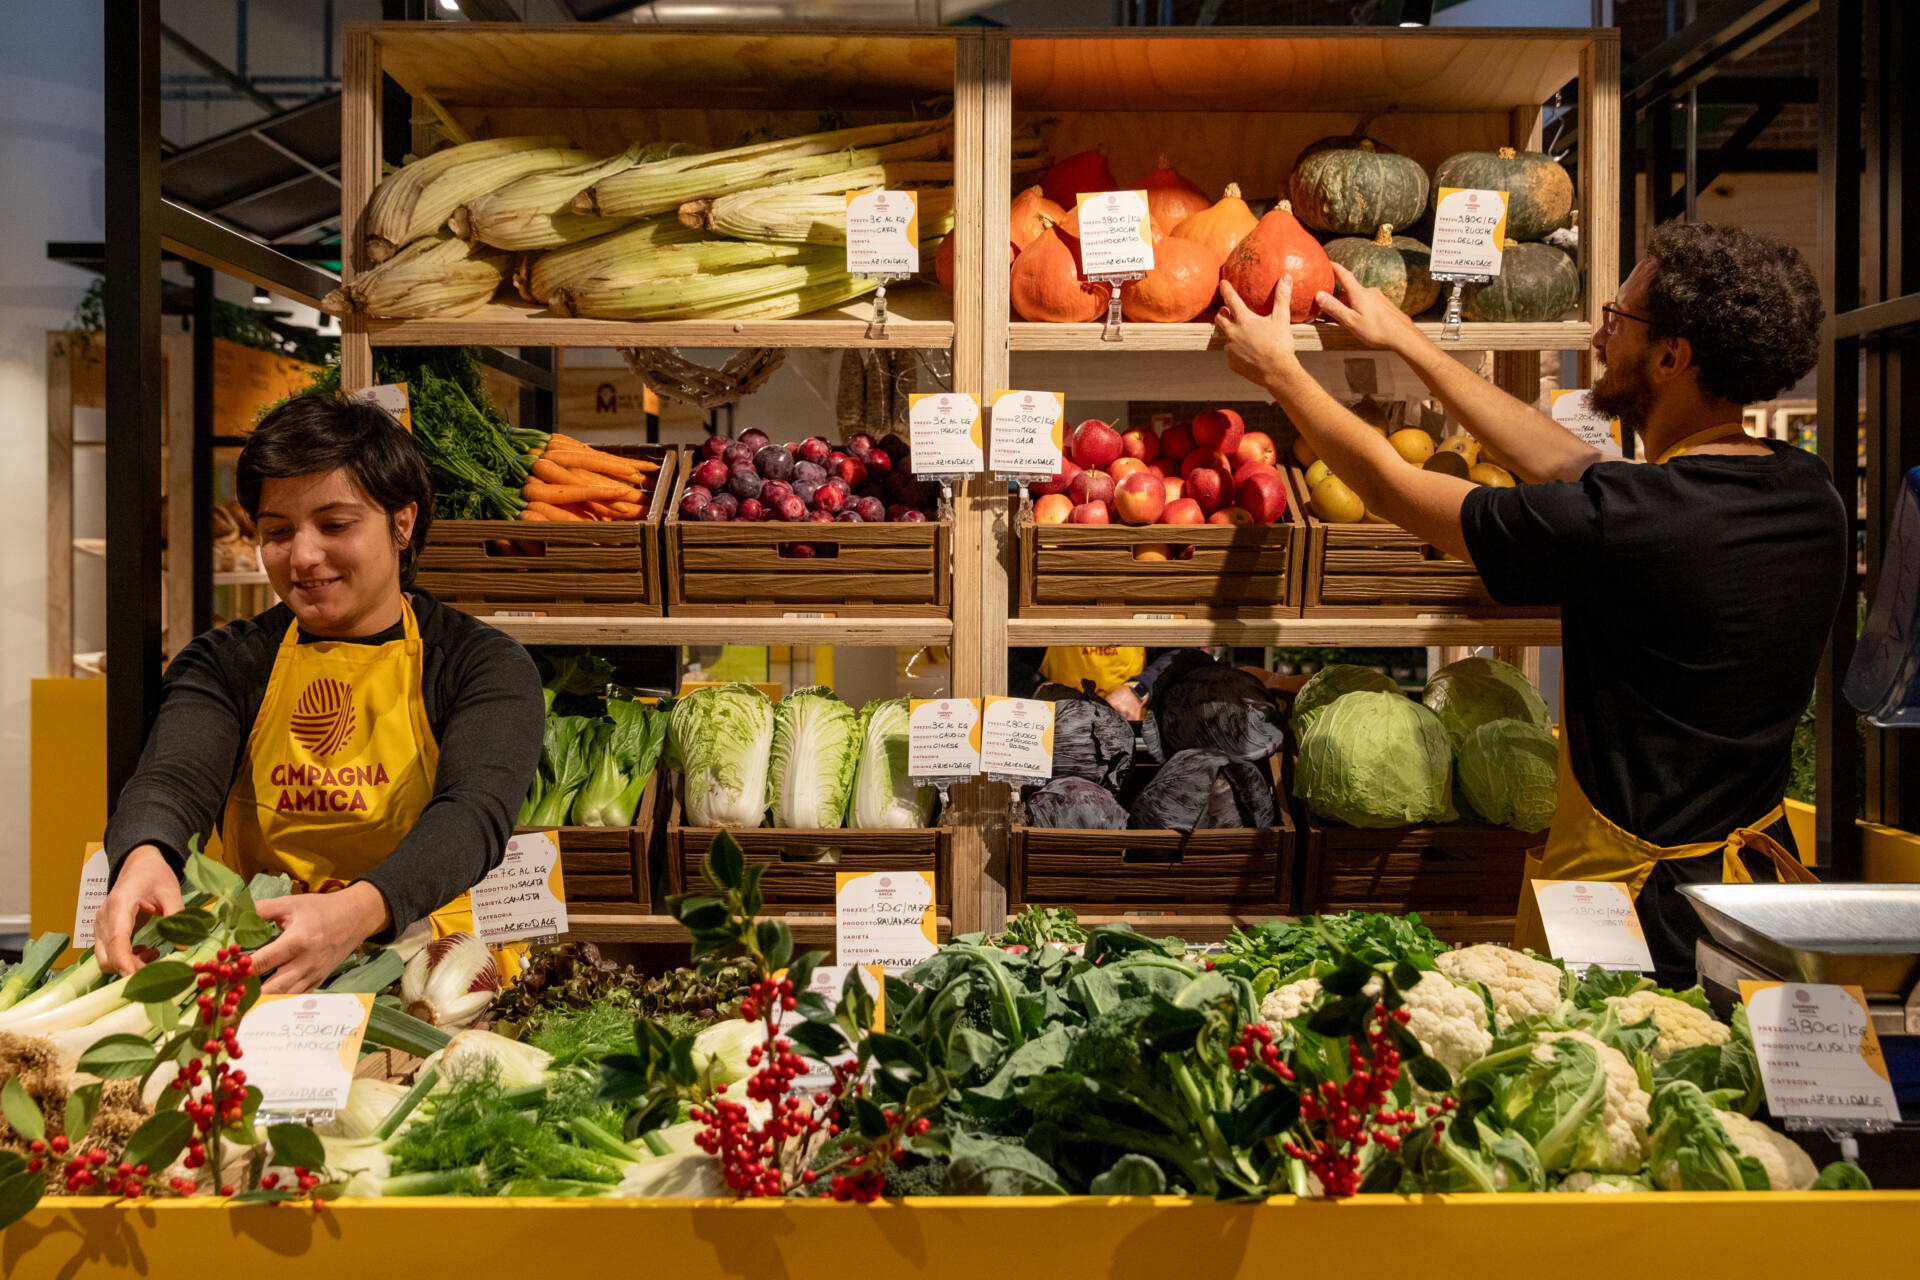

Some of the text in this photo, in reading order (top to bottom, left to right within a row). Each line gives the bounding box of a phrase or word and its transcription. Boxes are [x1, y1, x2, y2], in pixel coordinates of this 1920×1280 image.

[276, 789, 368, 812] AMICA
[520, 868, 530, 876] AL
[476, 886, 508, 894] PRODOTTO
